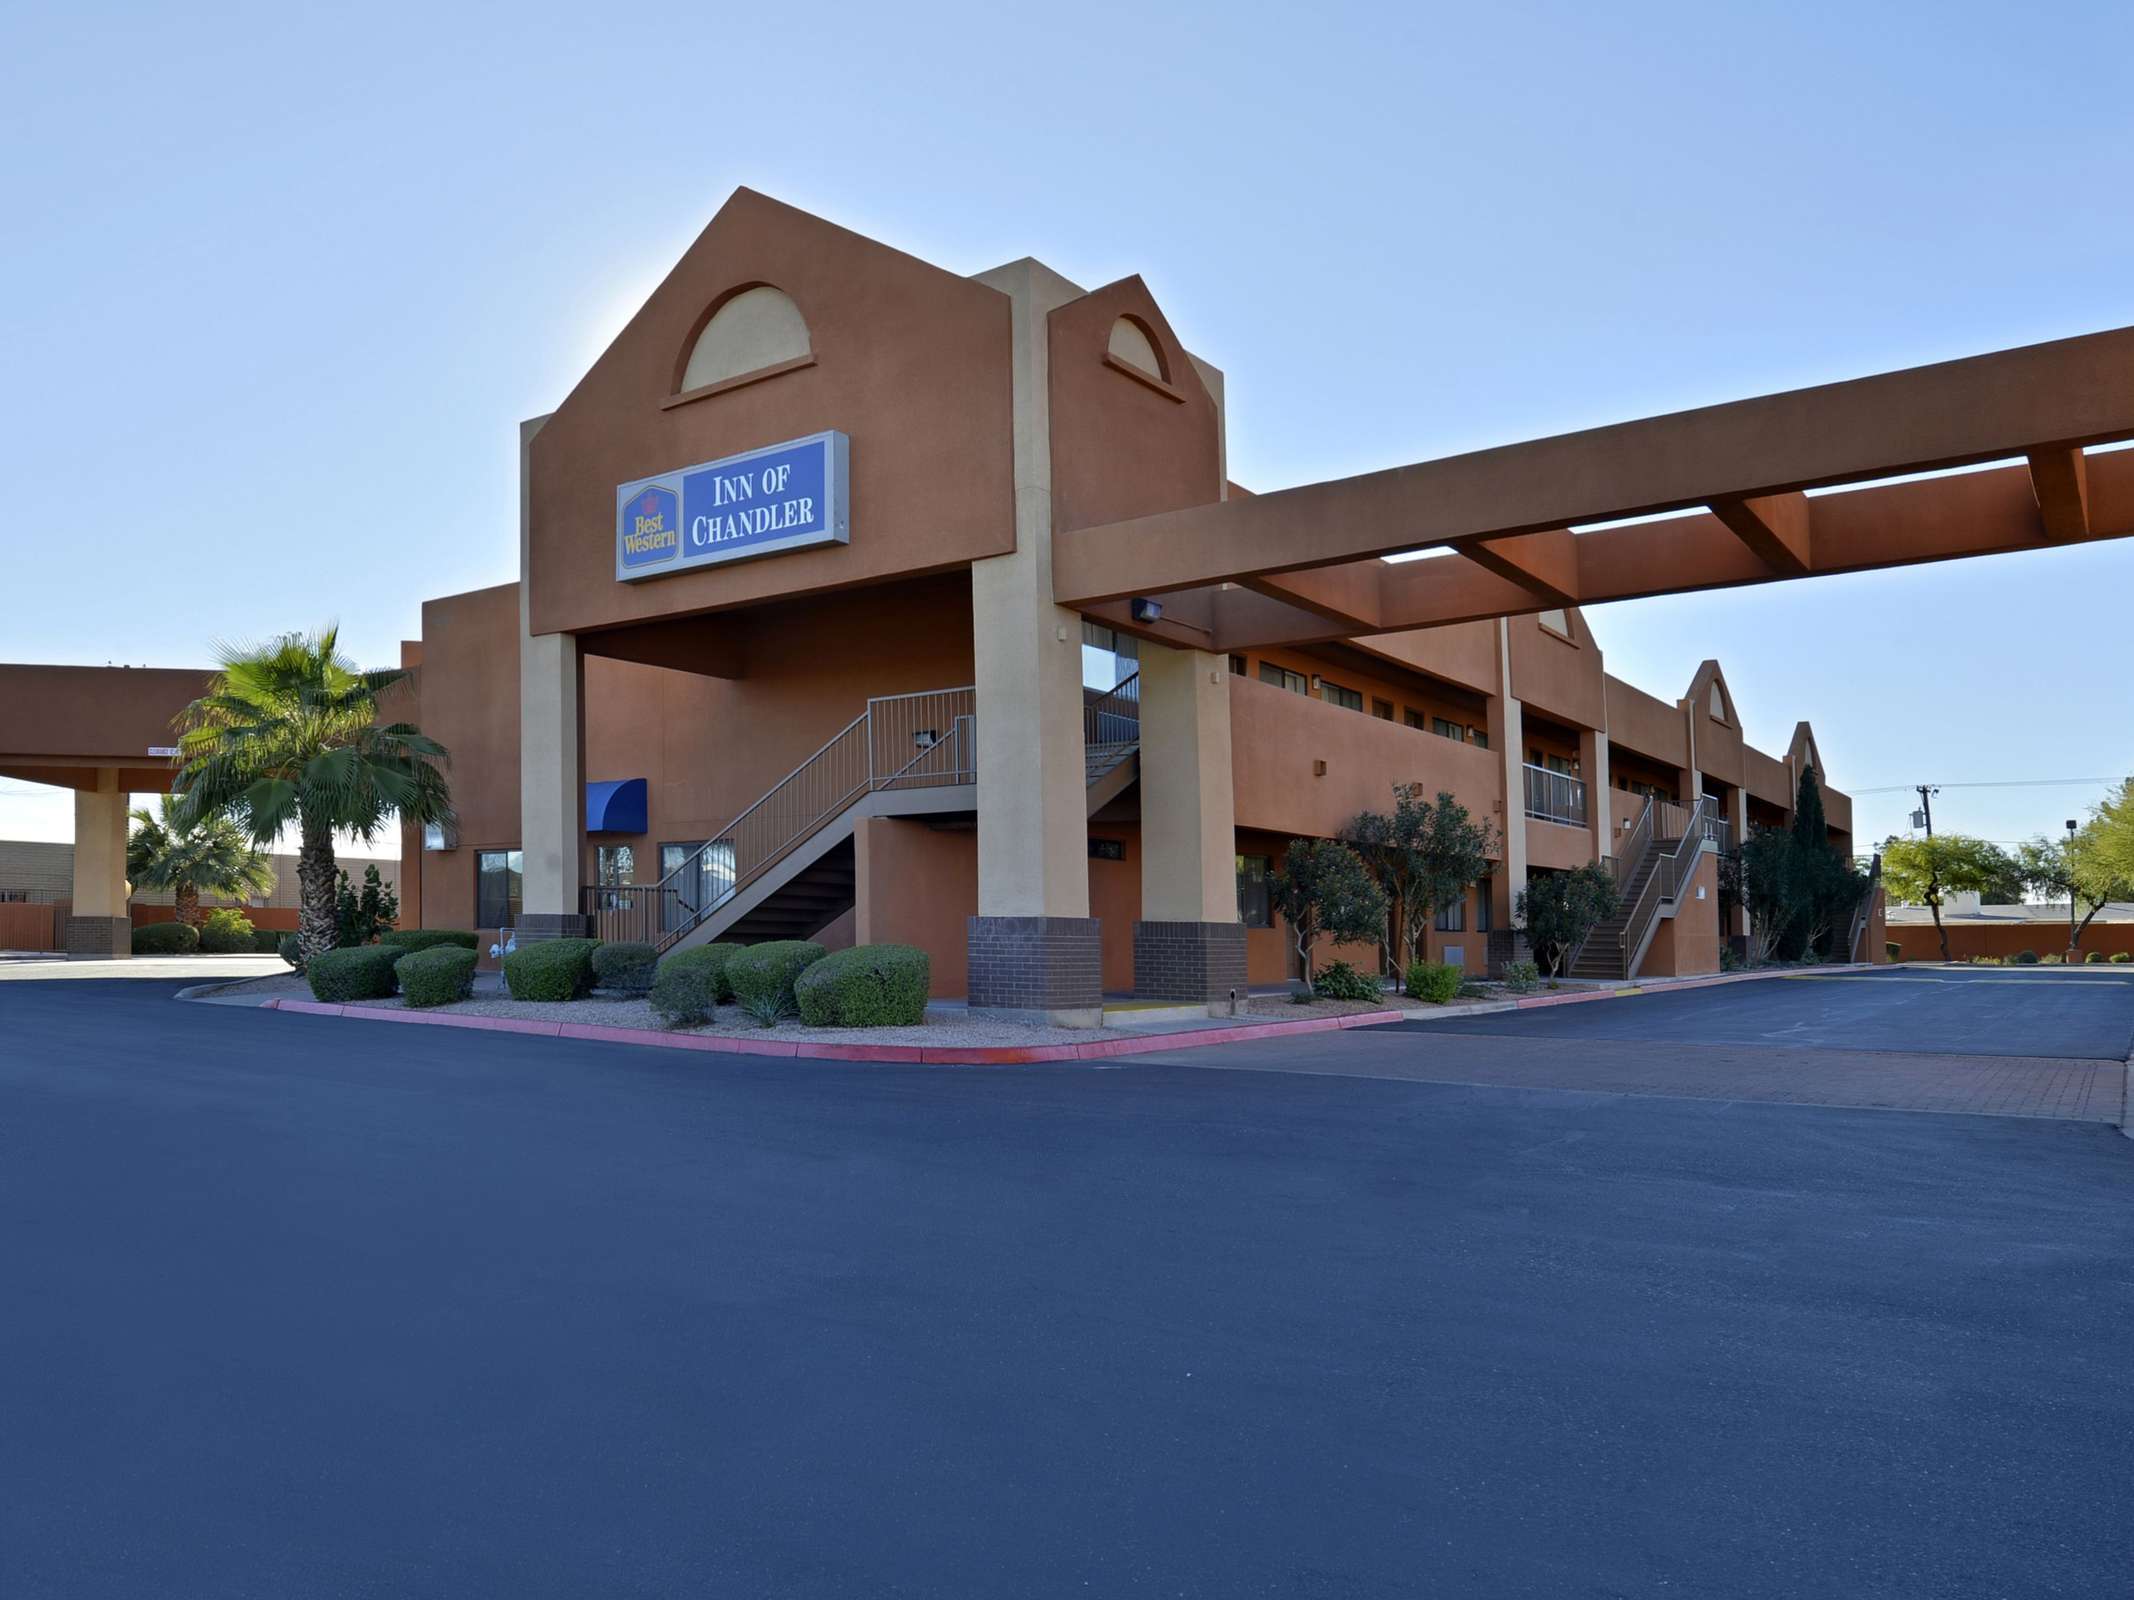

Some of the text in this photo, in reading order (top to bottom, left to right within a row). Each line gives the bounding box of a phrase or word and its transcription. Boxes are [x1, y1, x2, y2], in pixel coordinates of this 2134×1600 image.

[713, 464, 791, 507] INN OF
[635, 513, 664, 535] Best
[692, 497, 815, 546] CHANDLER
[624, 528, 676, 555] Western
